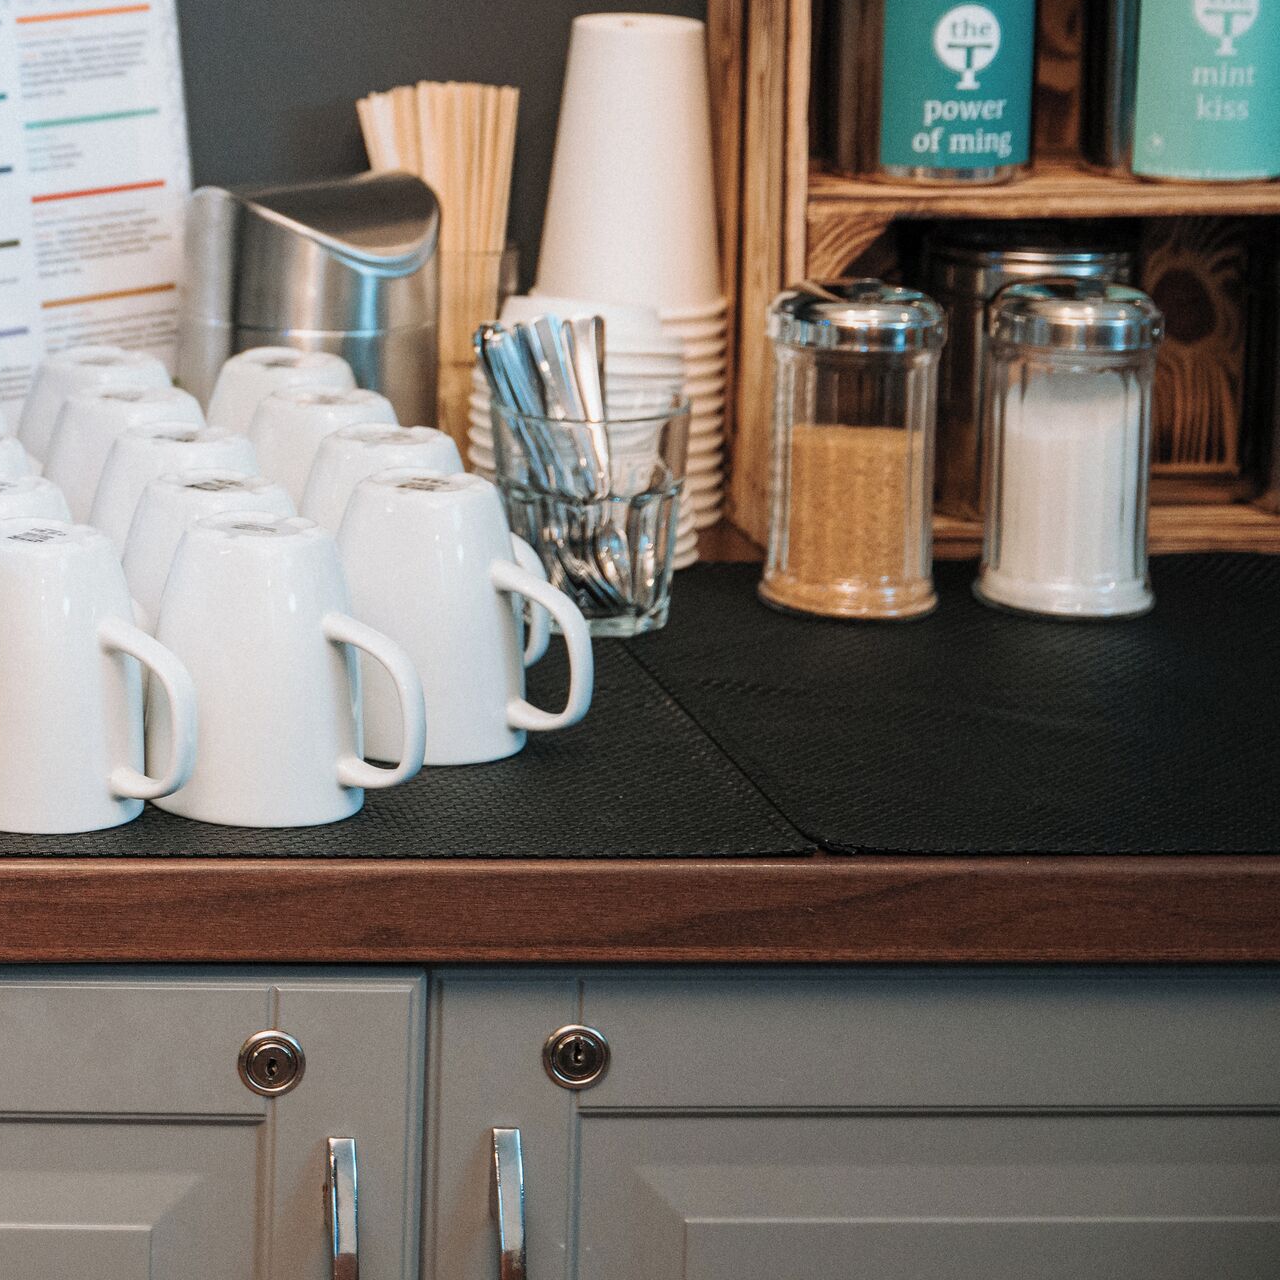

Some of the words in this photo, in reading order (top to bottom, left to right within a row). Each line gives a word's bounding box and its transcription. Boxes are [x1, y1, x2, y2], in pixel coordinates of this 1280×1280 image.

[950, 18, 991, 38] the
[947, 44, 992, 69] T
[1192, 63, 1255, 86] mint
[923, 98, 1007, 127] power
[1196, 94, 1249, 120] kiss
[912, 127, 944, 154] of
[949, 128, 1013, 159] ming
